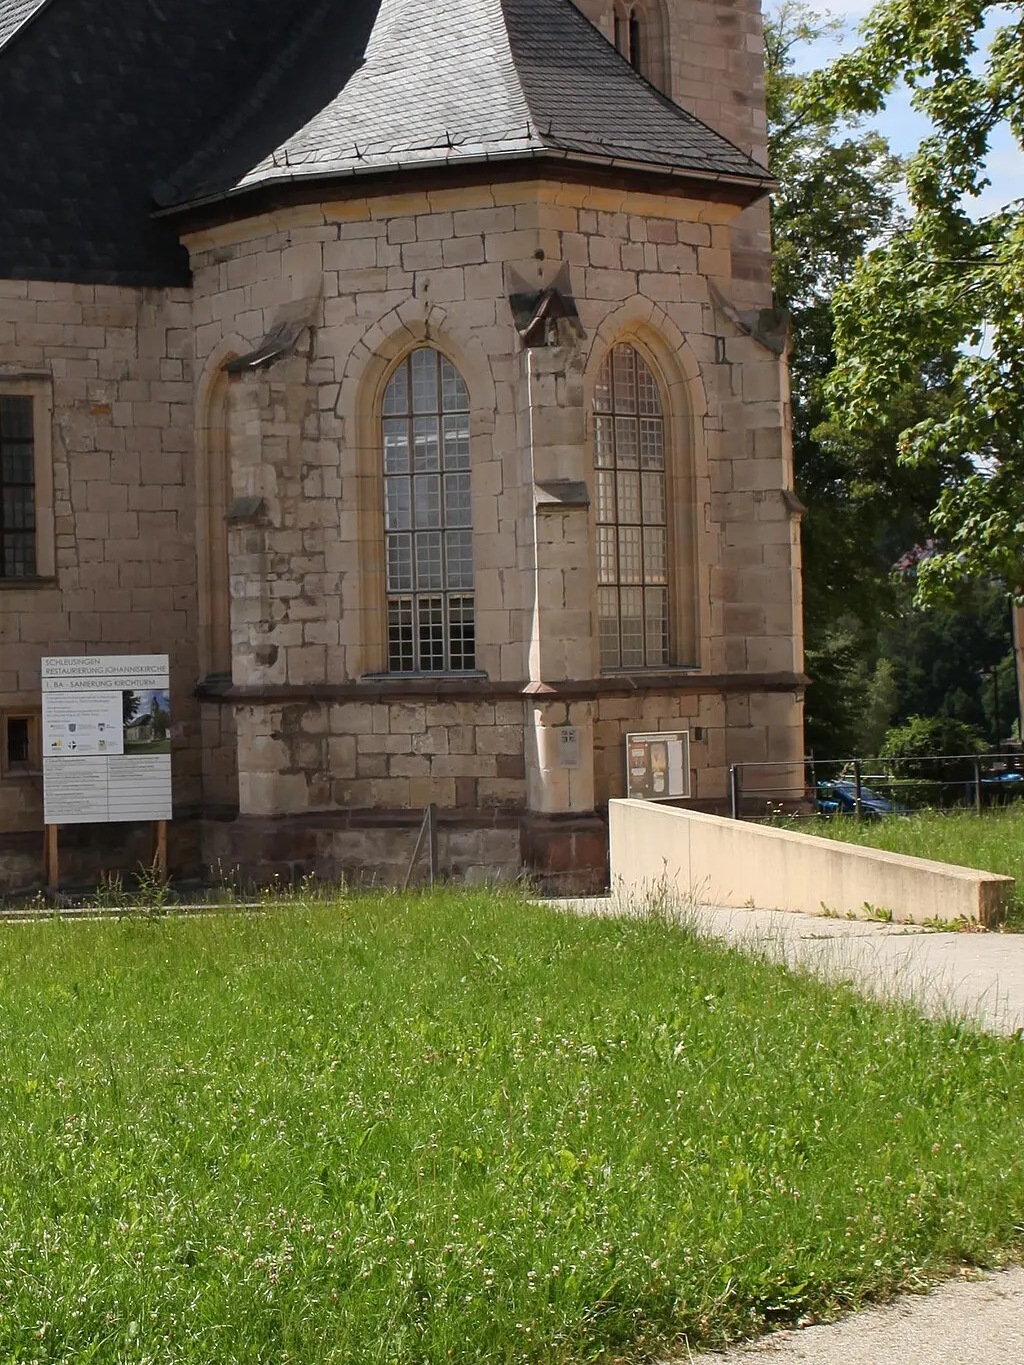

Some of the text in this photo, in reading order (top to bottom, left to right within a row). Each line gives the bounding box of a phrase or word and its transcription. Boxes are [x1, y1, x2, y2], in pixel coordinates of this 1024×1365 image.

[45, 658, 100, 666] SCHLEUSINGEN
[45, 665, 166, 675] RESTAURIERUNG JOHANNISKIRCHE
[114, 679, 155, 687] KIRCHTURM
